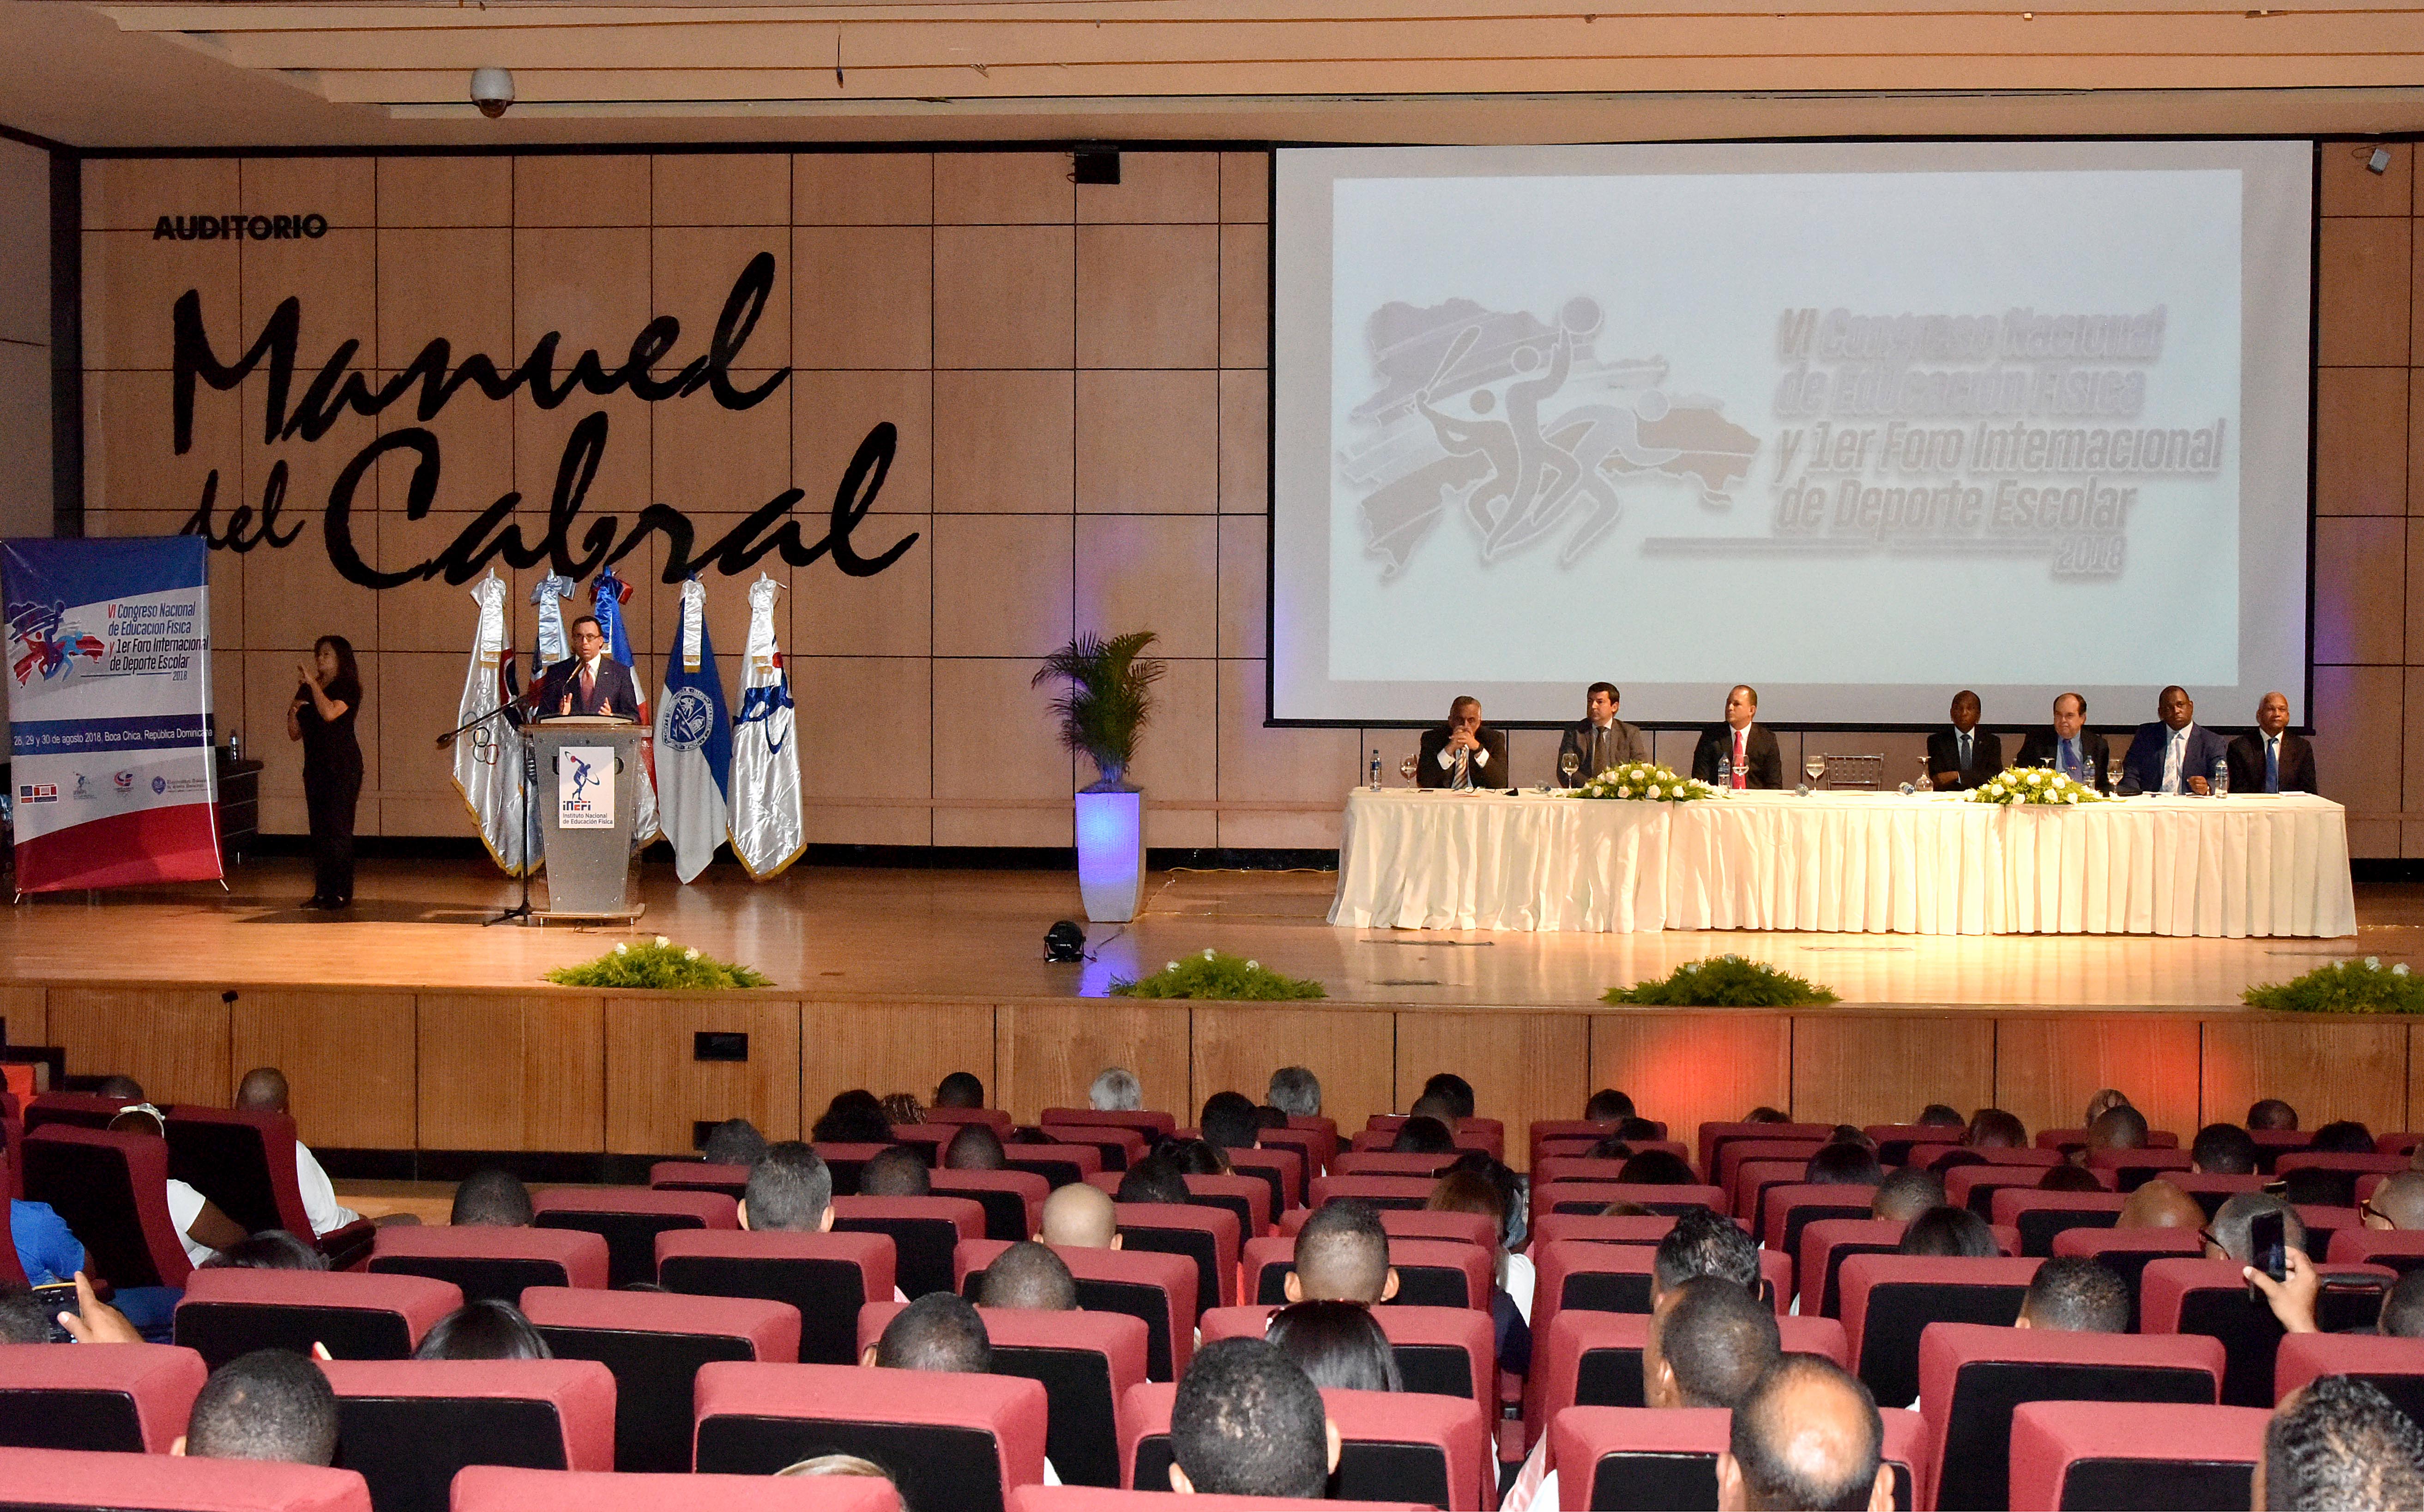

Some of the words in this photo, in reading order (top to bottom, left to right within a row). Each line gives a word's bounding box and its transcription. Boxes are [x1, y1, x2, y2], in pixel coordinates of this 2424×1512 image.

[153, 214, 327, 240] AUDITORIO
[173, 251, 791, 455] Manuel
[1780, 308, 1816, 360] VI
[1818, 308, 1996, 375] Congreso
[2001, 305, 2167, 361] Nacional
[1774, 363, 1827, 415] de
[1774, 428, 1803, 486] y
[1808, 421, 1876, 473] 1er
[1879, 421, 1965, 473] Foro
[1972, 417, 2226, 473] Internacional
[325, 411, 919, 589] Cabral
[1776, 476, 1826, 530] de
[1834, 478, 1984, 542] Deporte
[1990, 476, 2139, 530] Escolar
[2054, 535, 2127, 578] 2018
[108, 604, 116, 618] VI
[118, 604, 157, 622] Congreso
[159, 601, 196, 617] Nacional
[108, 621, 119, 636] de
[109, 641, 115, 658] y
[116, 639, 132, 654] 1er
[133, 638, 151, 653] Foro
[153, 635, 209, 652] Internacional
[110, 656, 121, 671] de
[122, 655, 156, 675] Deporte
[158, 654, 190, 669] Escolar
[172, 670, 187, 681] 2018
[14, 735, 24, 746] 28,
[25, 735, 34, 745] 29
[36, 737, 40, 747] y
[42, 734, 50, 744] 30
[52, 734, 60, 744] de
[61, 735, 84, 746] agosto
[104, 731, 121, 741] Boca
[144, 729, 175, 741] República
[176, 728, 213, 738] Dominicana
